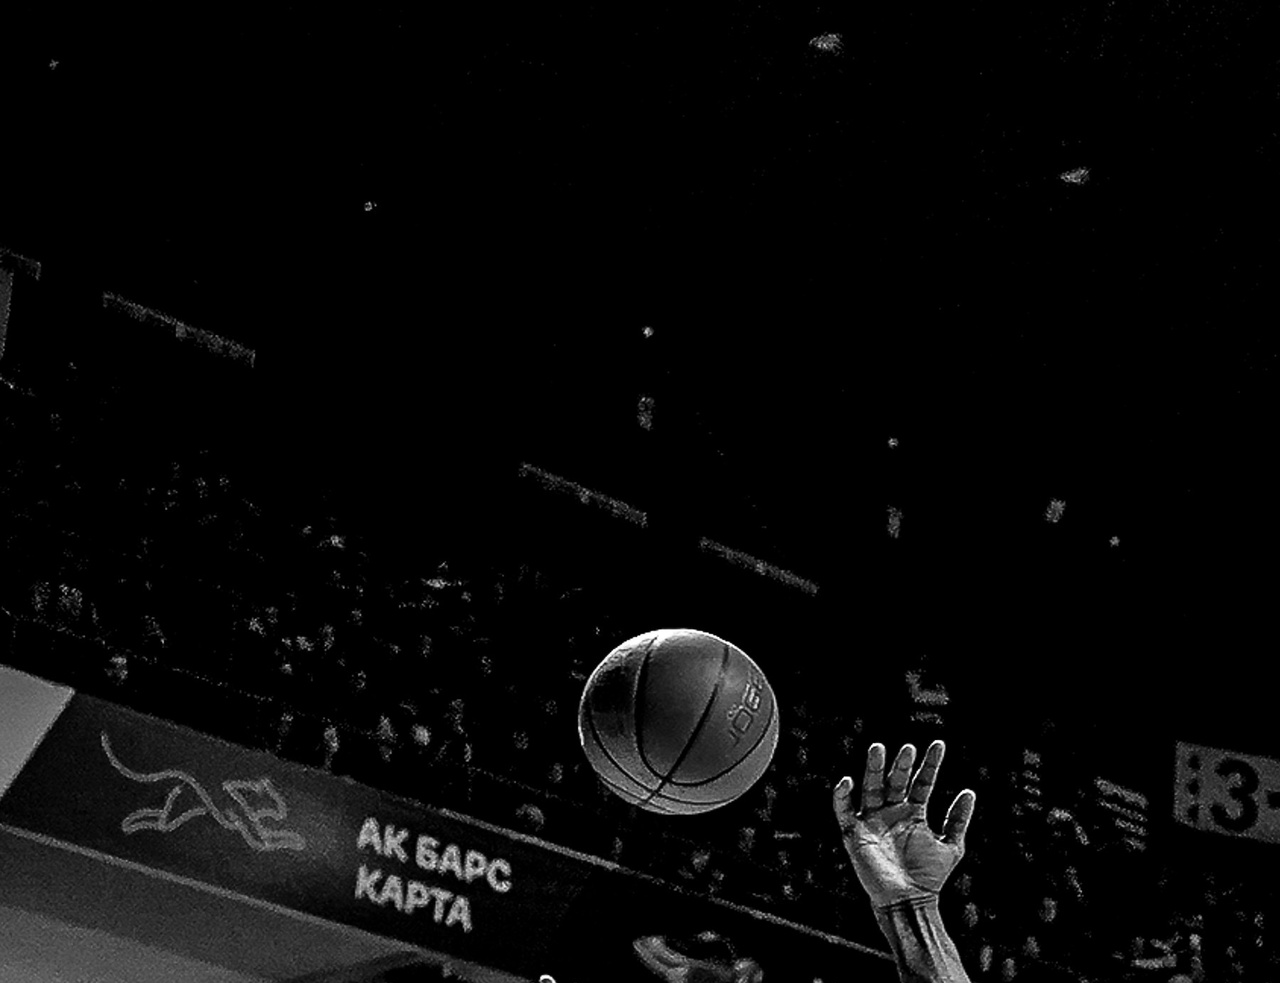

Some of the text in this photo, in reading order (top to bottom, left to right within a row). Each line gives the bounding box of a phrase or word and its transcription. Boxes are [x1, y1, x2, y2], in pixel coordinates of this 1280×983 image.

[357, 816, 513, 893] АК БАРС
[354, 863, 473, 933] КАРТА
